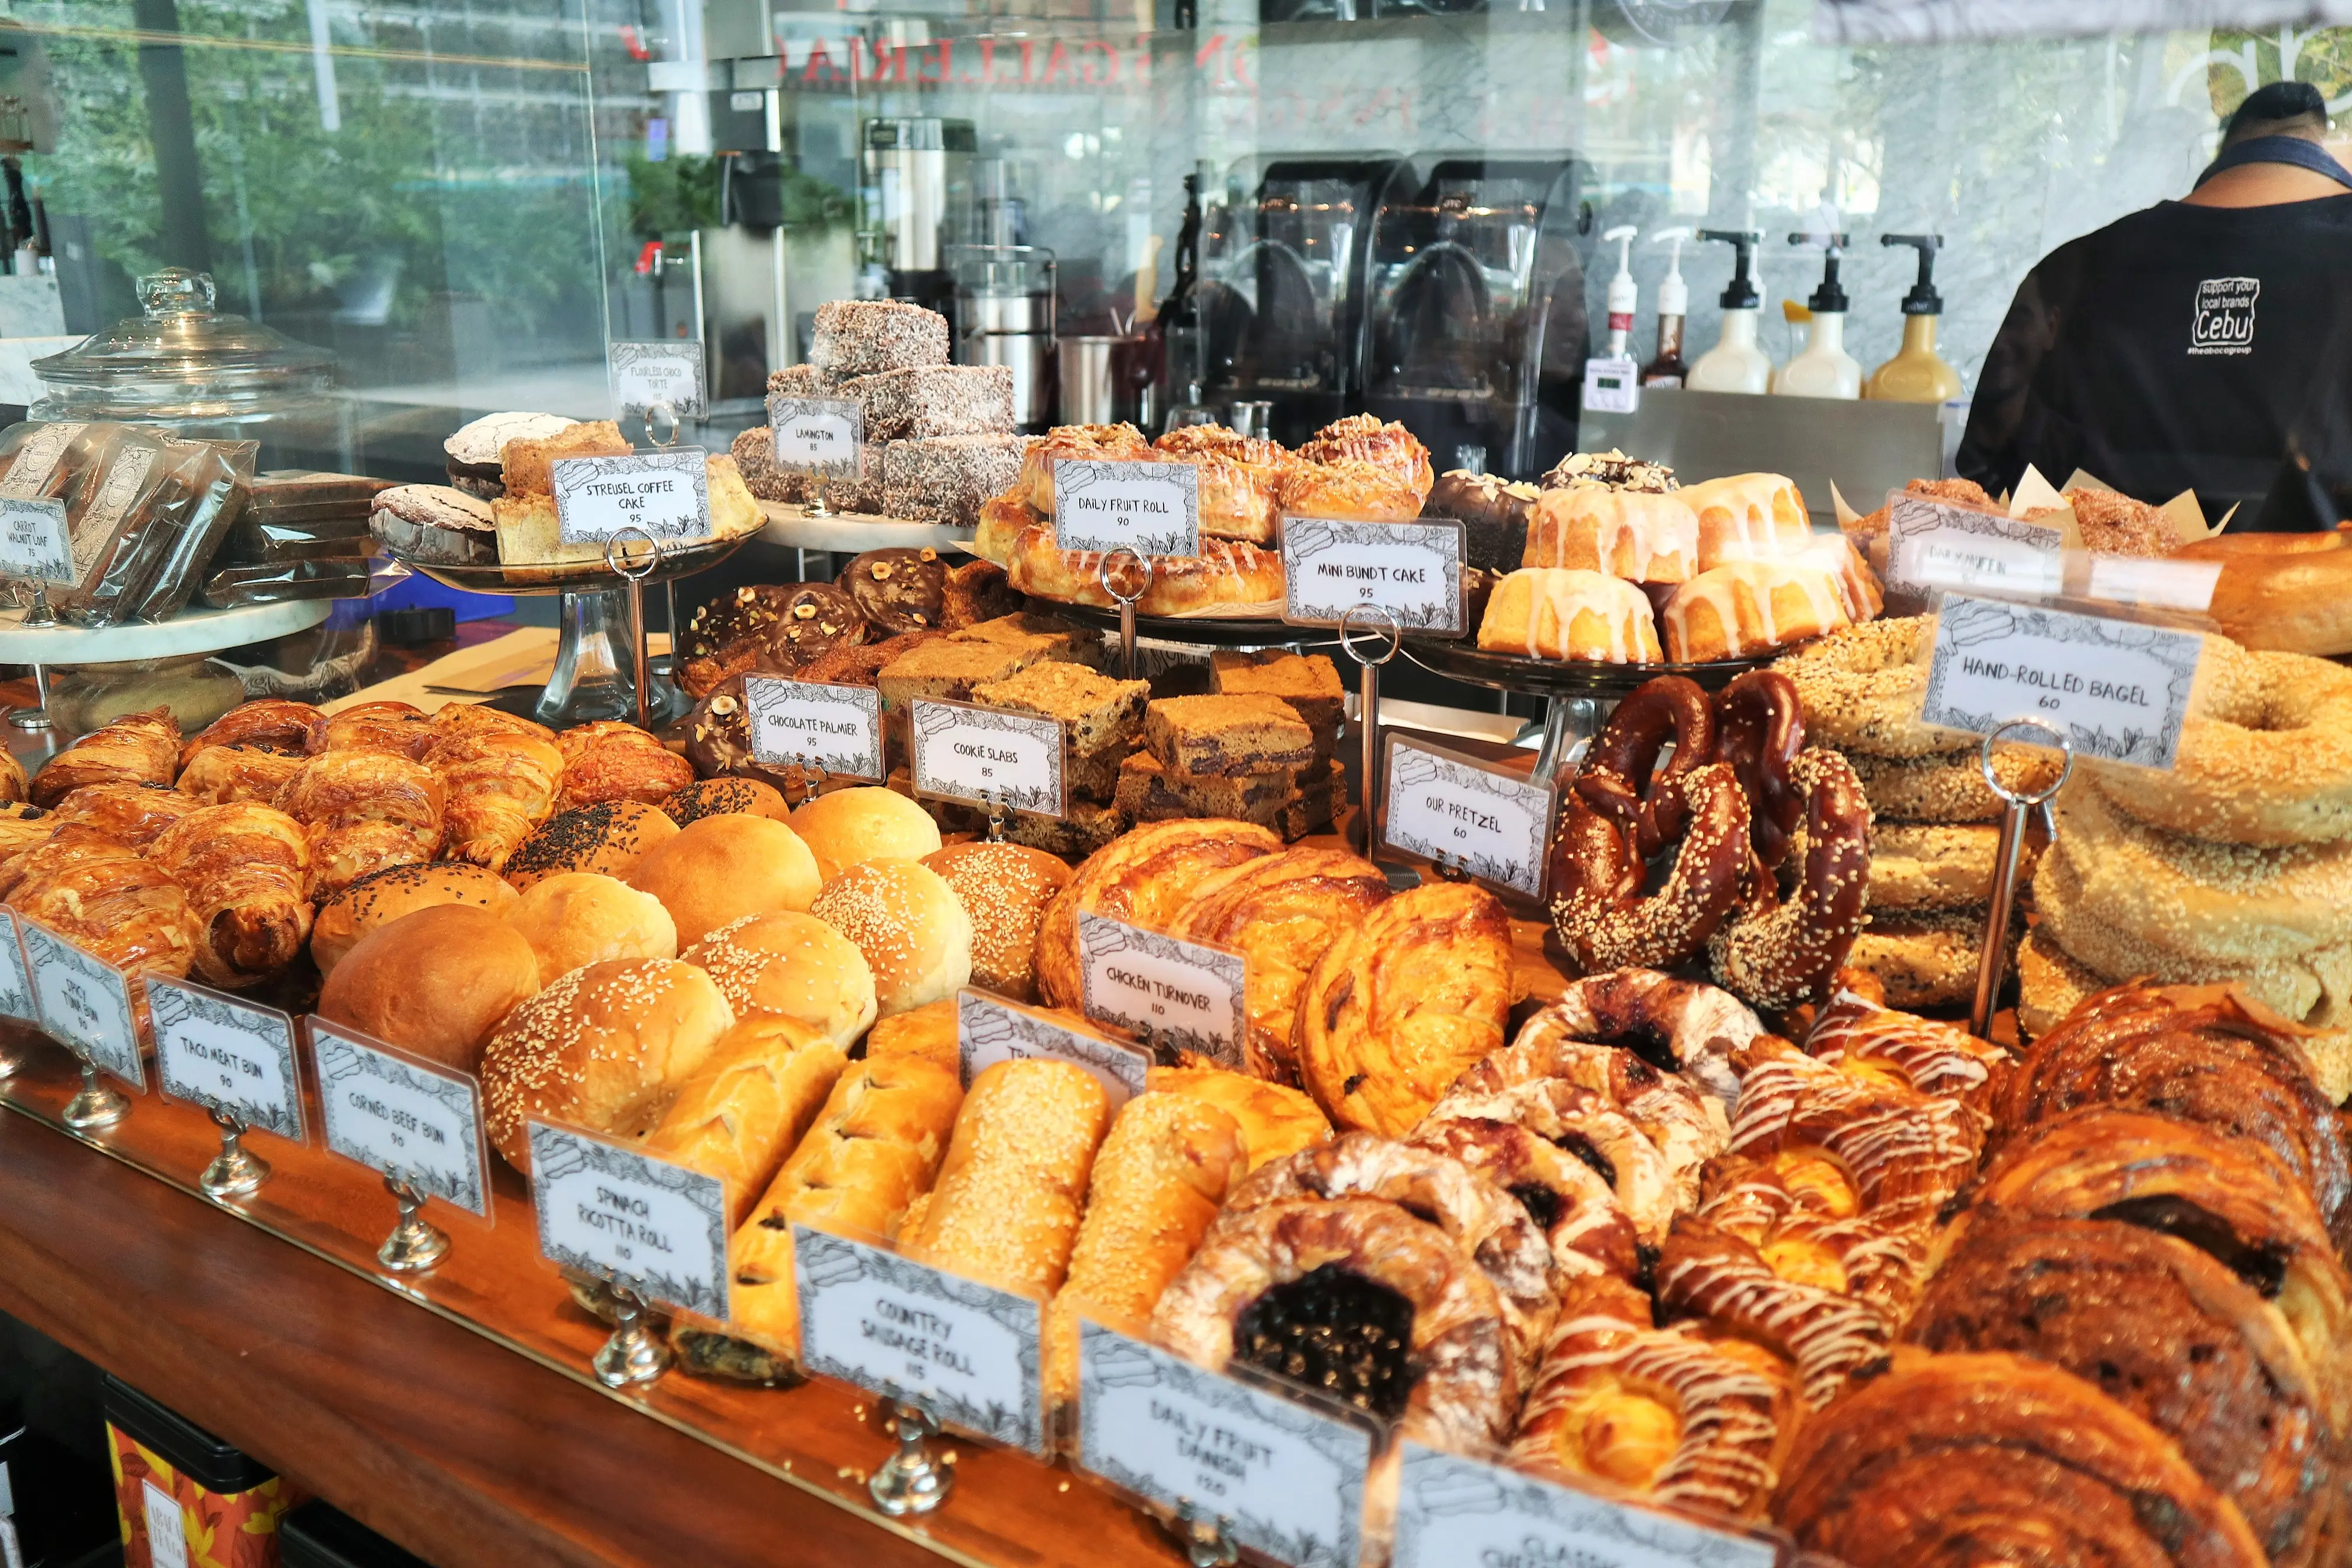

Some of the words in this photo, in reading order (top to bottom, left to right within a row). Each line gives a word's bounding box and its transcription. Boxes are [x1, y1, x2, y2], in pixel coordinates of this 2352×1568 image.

[2202, 280, 2235, 295] support
[2236, 281, 2256, 295] your
[2201, 296, 2221, 309] local
[2222, 295, 2250, 309] brands
[2197, 308, 2249, 340] Cebu
[795, 429, 834, 442] LAMINGTON
[809, 443, 818, 451] 85
[587, 483, 635, 496] STREUSEL
[638, 480, 674, 494] COFFEE
[619, 496, 645, 509] CAKE
[1079, 498, 1107, 512] DAILY
[1110, 499, 1140, 512] FRUIT
[1144, 500, 1169, 514] ROLL
[629, 514, 641, 522] 95
[1118, 517, 1129, 526] 90
[14, 521, 36, 534] CARROT
[6, 531, 31, 545] WALNUT
[32, 535, 47, 547] LOAF
[28, 548, 35, 557] 75
[1318, 563, 1342, 577] MINI
[1346, 565, 1388, 582] BUNDT
[1393, 569, 1426, 583] CAKE
[1359, 587, 1373, 598] 95
[1964, 655, 2085, 694] HAND-ROLLED
[2090, 680, 2150, 707] BAGEL
[2039, 696, 2060, 710] 60
[768, 714, 818, 732] CHOCOLATE
[819, 720, 858, 737] PALMIER
[807, 737, 817, 747] 95
[954, 743, 985, 759] COOKIE
[987, 748, 1018, 764] SLABS
[982, 767, 993, 778] 85
[1426, 796, 1444, 814] OUR
[1449, 803, 1502, 834] PRETZEL
[1453, 827, 1466, 839] 60
[66, 978, 86, 1002] SPICY
[1106, 966, 1151, 994] CHICKEN
[1153, 980, 1212, 1014] TURNOVER
[1151, 1003, 1165, 1015] 110
[78, 1016, 87, 1030] 90
[180, 1036, 208, 1060] TACO
[210, 1048, 240, 1071] MEAT
[241, 1059, 264, 1080] BUN
[220, 1074, 232, 1088] 90
[348, 1092, 389, 1121] CORNED
[391, 1109, 418, 1134] BEEF
[421, 1122, 446, 1146] BUN
[390, 1132, 405, 1148] 90
